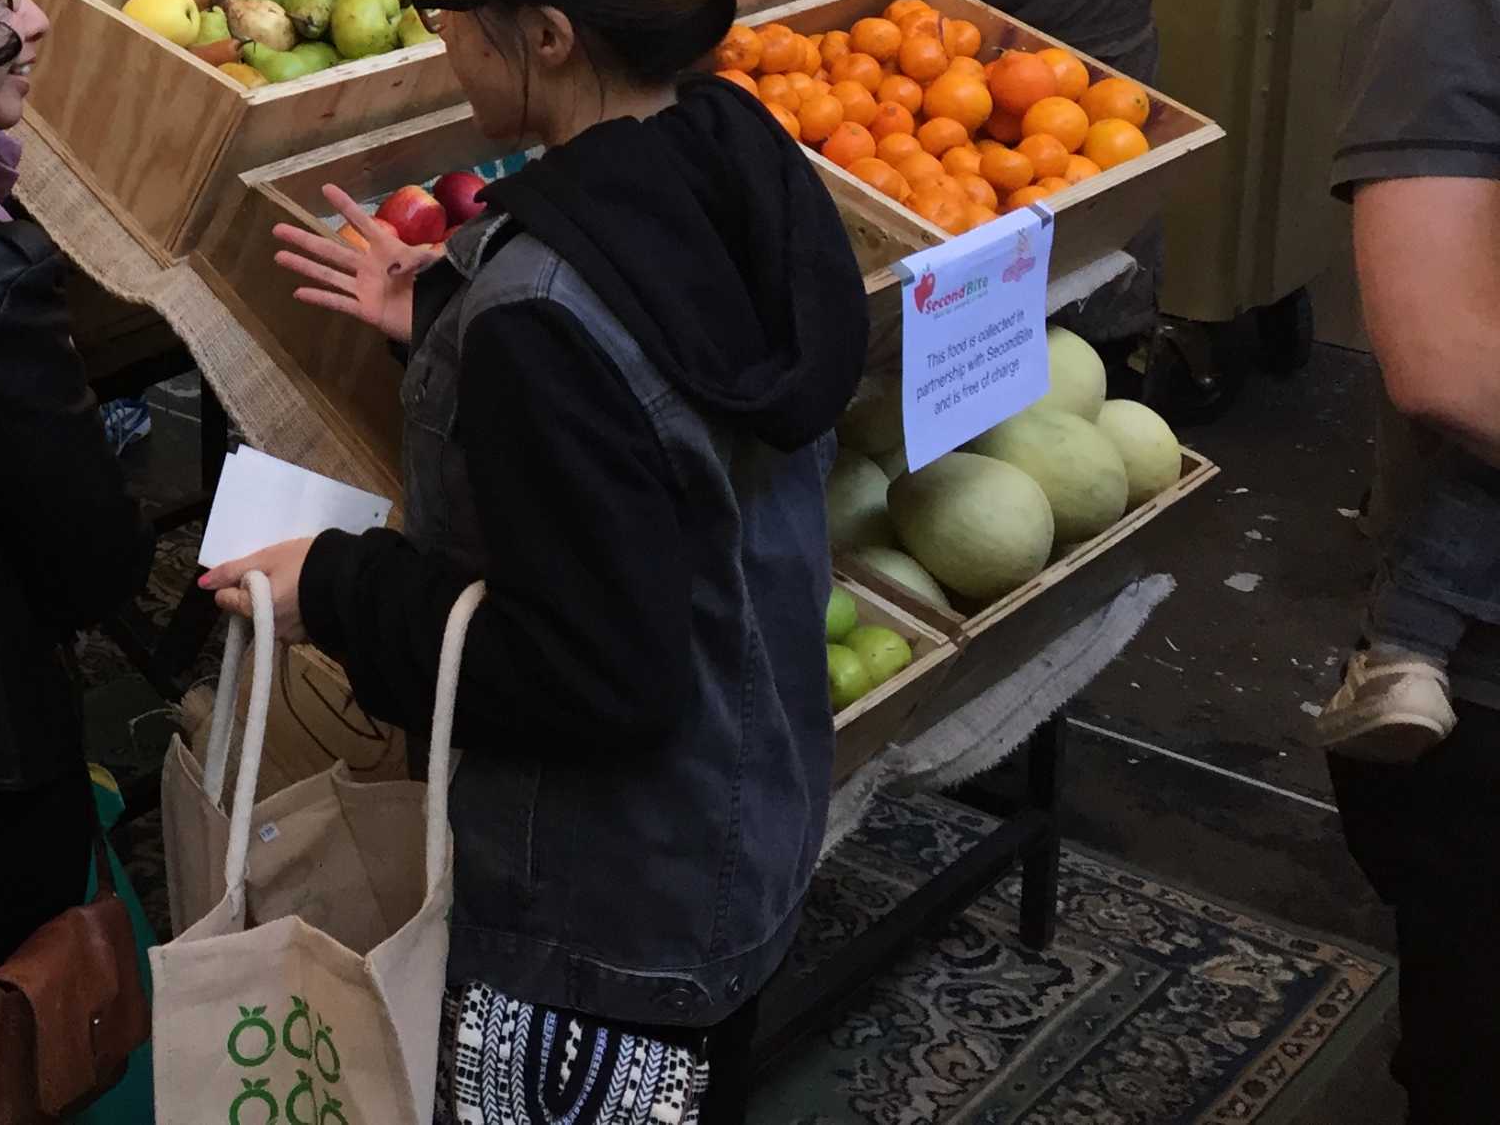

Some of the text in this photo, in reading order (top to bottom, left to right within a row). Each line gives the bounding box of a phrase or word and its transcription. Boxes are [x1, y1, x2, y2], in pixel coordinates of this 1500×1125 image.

[924, 275, 989, 315] SecondBite
[916, 327, 1034, 404] partnership with SecondBite
[927, 351, 946, 369] This
[947, 338, 968, 359] food
[978, 312, 1016, 343] collected
[934, 394, 951, 416] and
[962, 380, 980, 397] free
[980, 371, 990, 390] of
[991, 357, 1020, 384] charge
